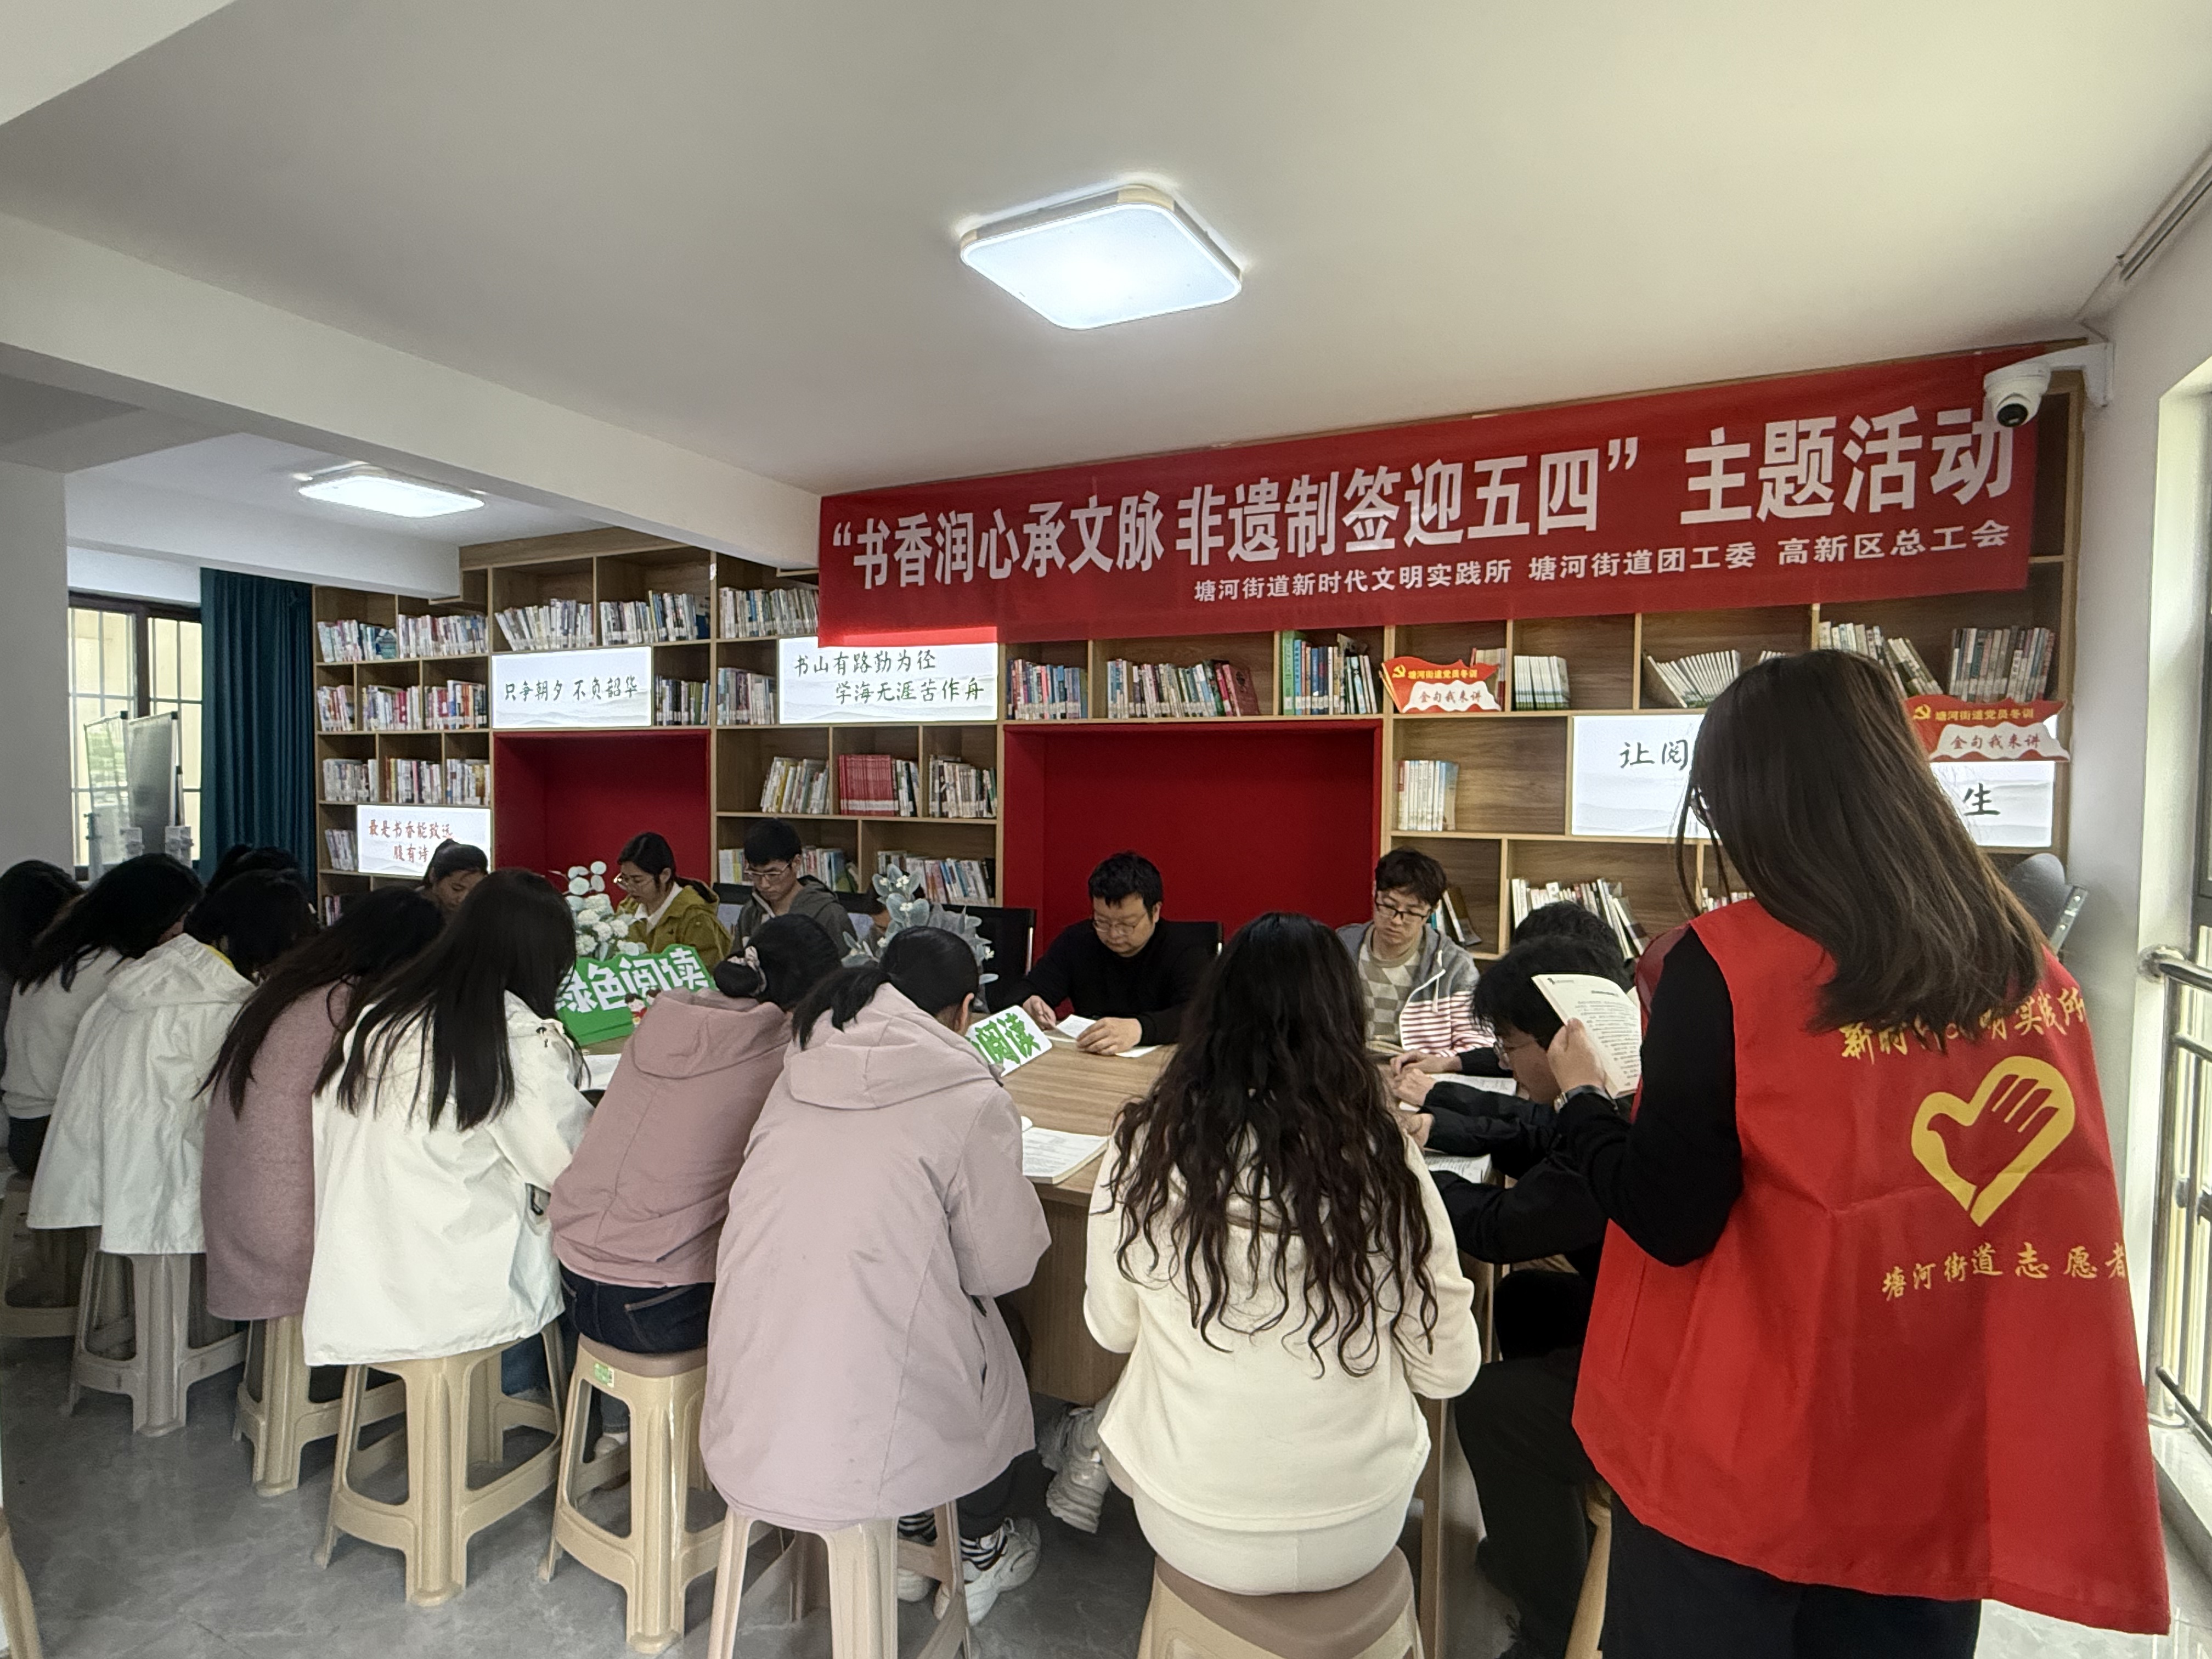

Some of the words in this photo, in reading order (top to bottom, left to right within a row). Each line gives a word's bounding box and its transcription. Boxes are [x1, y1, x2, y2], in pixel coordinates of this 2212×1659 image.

[833, 491, 1164, 589] “书香润心承文脉
[1176, 437, 1638, 566] 非遗制签迎五四”
[1680, 405, 2014, 525] 主题活动
[1194, 559, 1511, 602] 塘河街道新时代文明实践所
[1528, 541, 1756, 582] 塘河街道团工委
[1779, 520, 2010, 566] 高新区总工会
[794, 649, 936, 677] 书山有路勤为径
[505, 679, 563, 702] 只争朝夕
[573, 675, 637, 701] 不负韶华
[836, 678, 984, 705] 学海无涯苦作舟
[1419, 690, 1482, 703] 金句我来讲
[1950, 733, 2041, 749] 金句我来讲
[1620, 740, 1689, 771] 让阅
[1962, 783, 2001, 816] 生
[368, 819, 454, 839] 最是书香能致远
[393, 843, 430, 863] 腹有诗
[1882, 1242, 2128, 1301] 塘河街道志愿者
